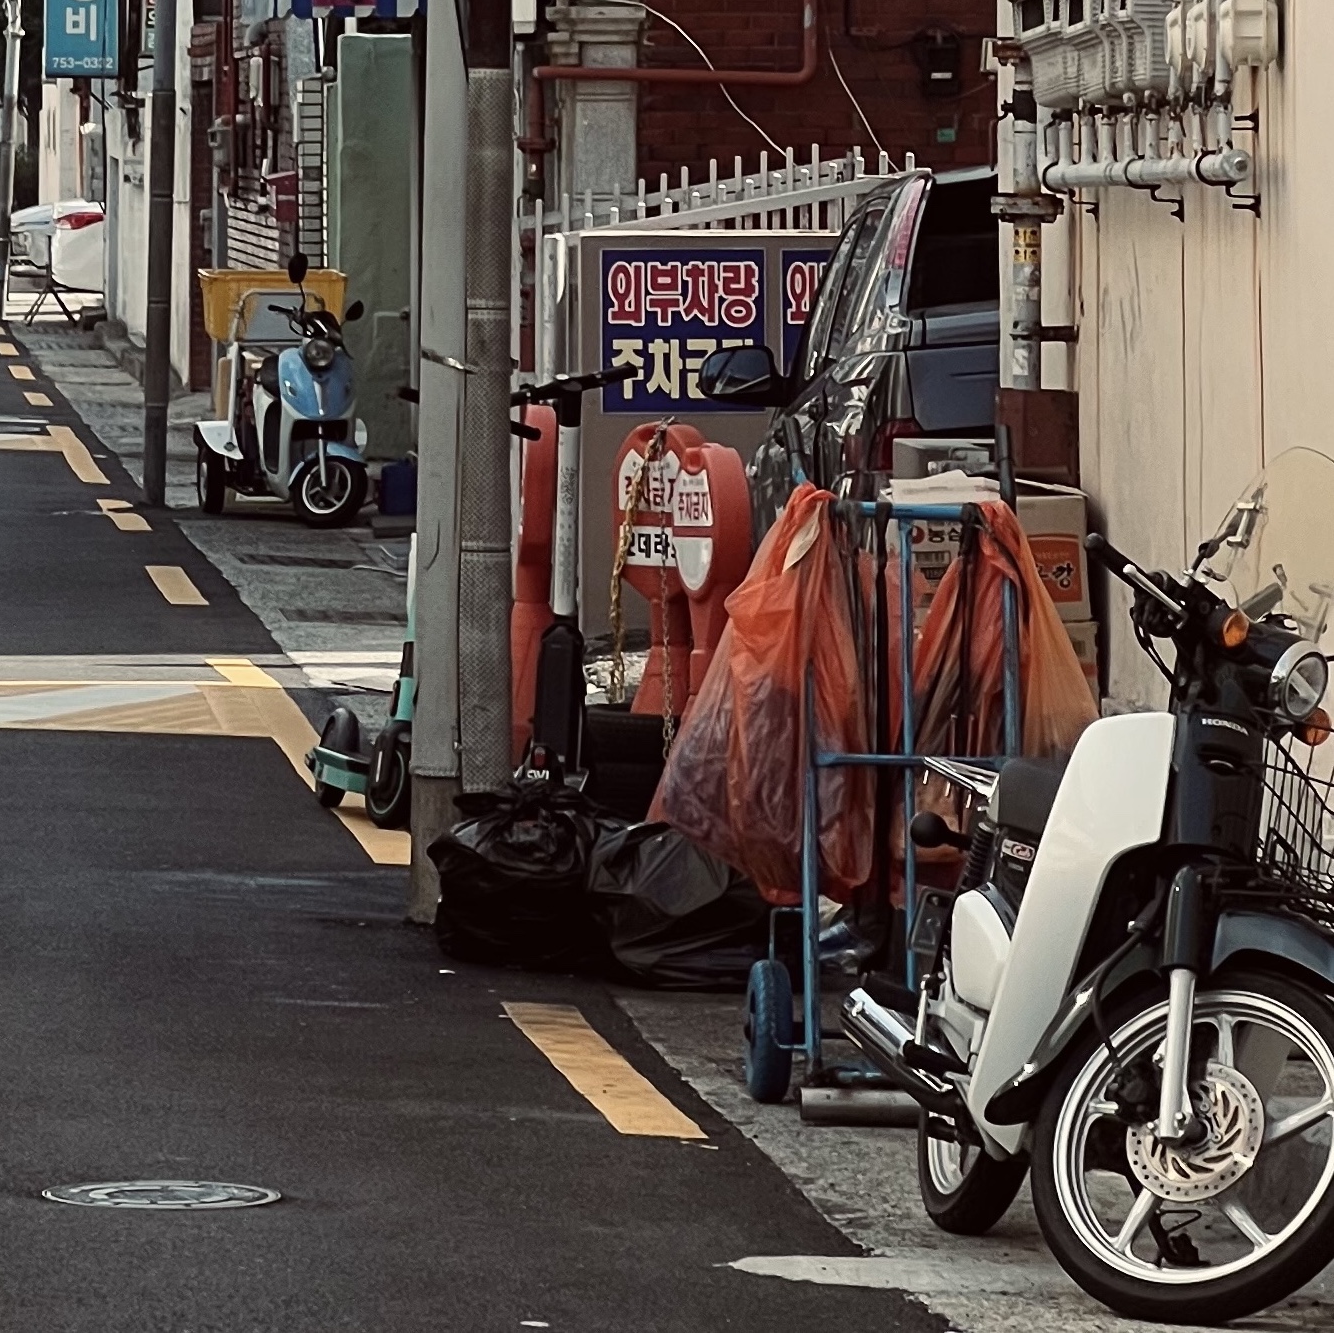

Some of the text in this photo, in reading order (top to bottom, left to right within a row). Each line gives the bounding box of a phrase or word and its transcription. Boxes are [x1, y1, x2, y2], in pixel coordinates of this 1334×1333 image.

[607, 260, 759, 328] 외부차량
[612, 338, 754, 400] 주차금
[1201, 718, 1250, 736] HONDA
